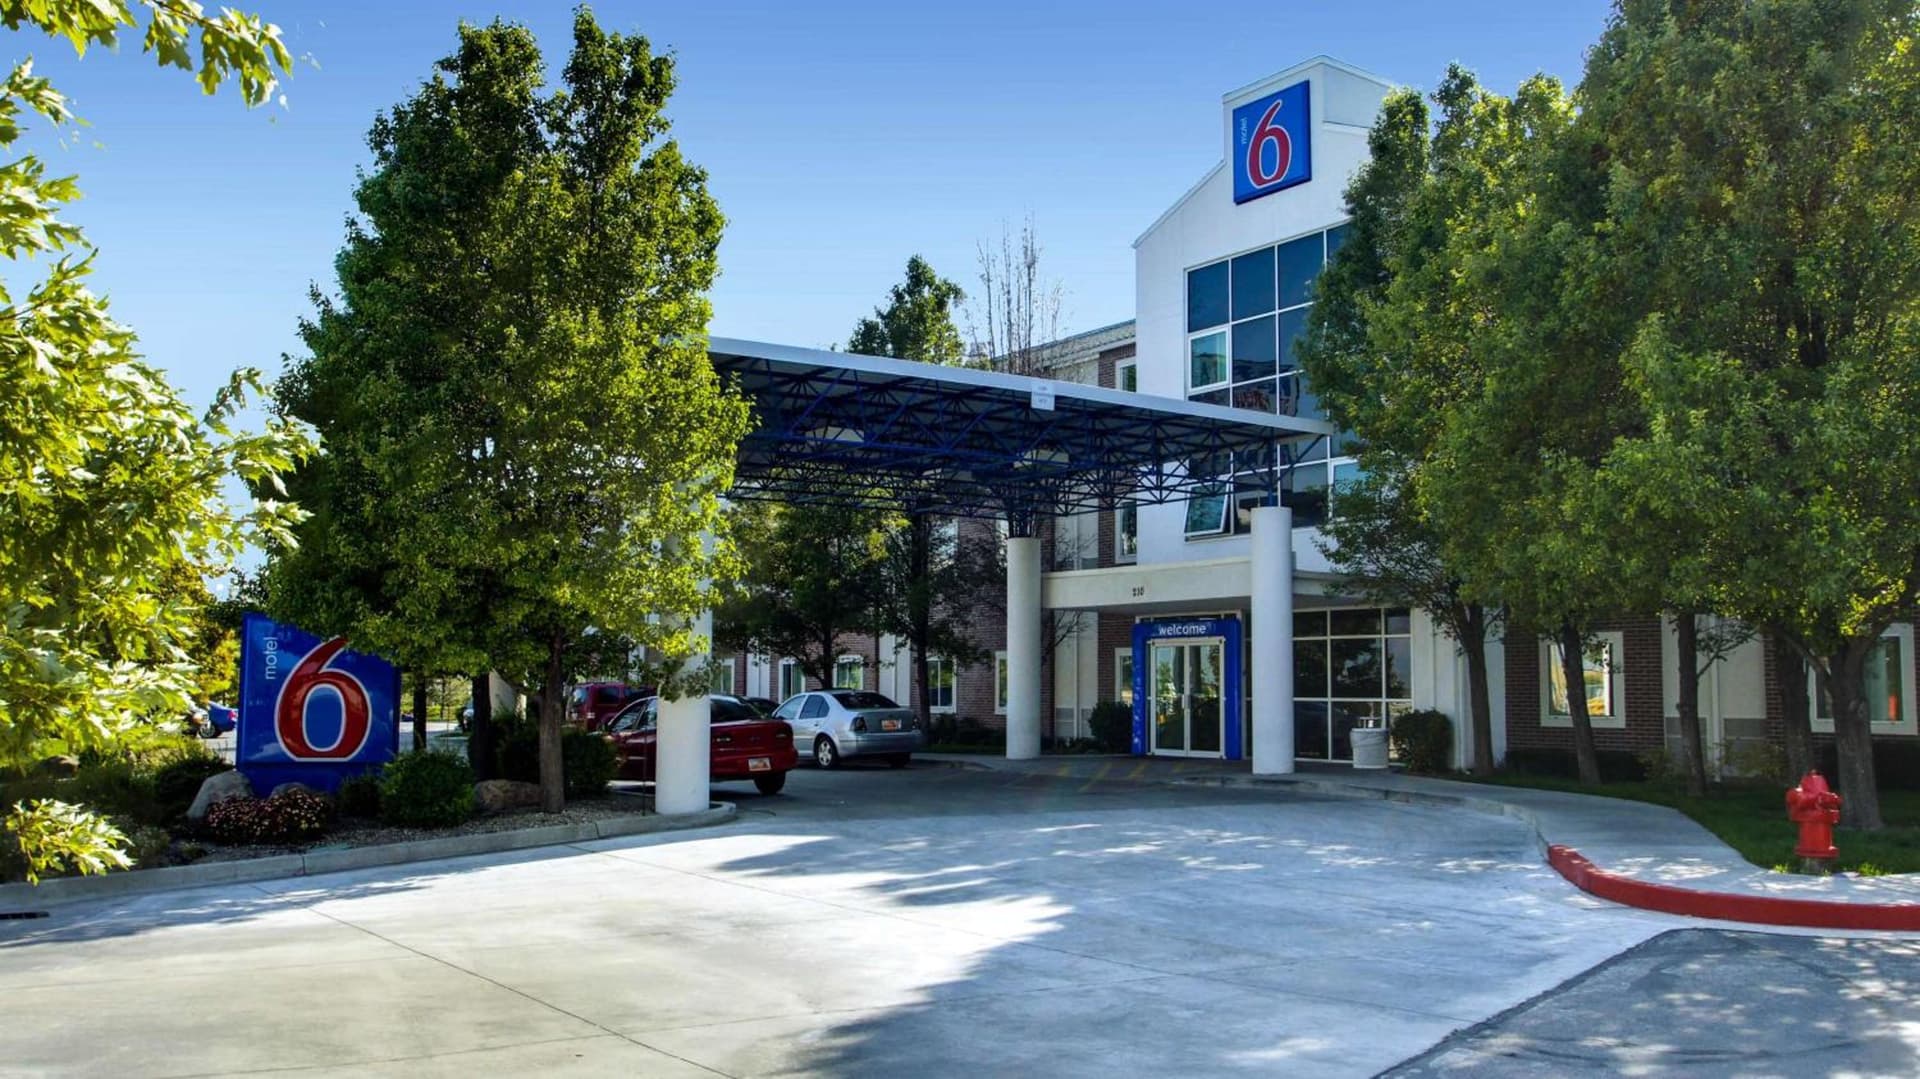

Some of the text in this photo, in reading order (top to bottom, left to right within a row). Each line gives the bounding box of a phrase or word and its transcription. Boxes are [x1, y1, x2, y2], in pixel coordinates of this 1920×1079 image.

[1247, 99, 1292, 189] 6
[263, 636, 278, 680] motel
[1158, 623, 1207, 636] welcome
[274, 635, 373, 762] 6
